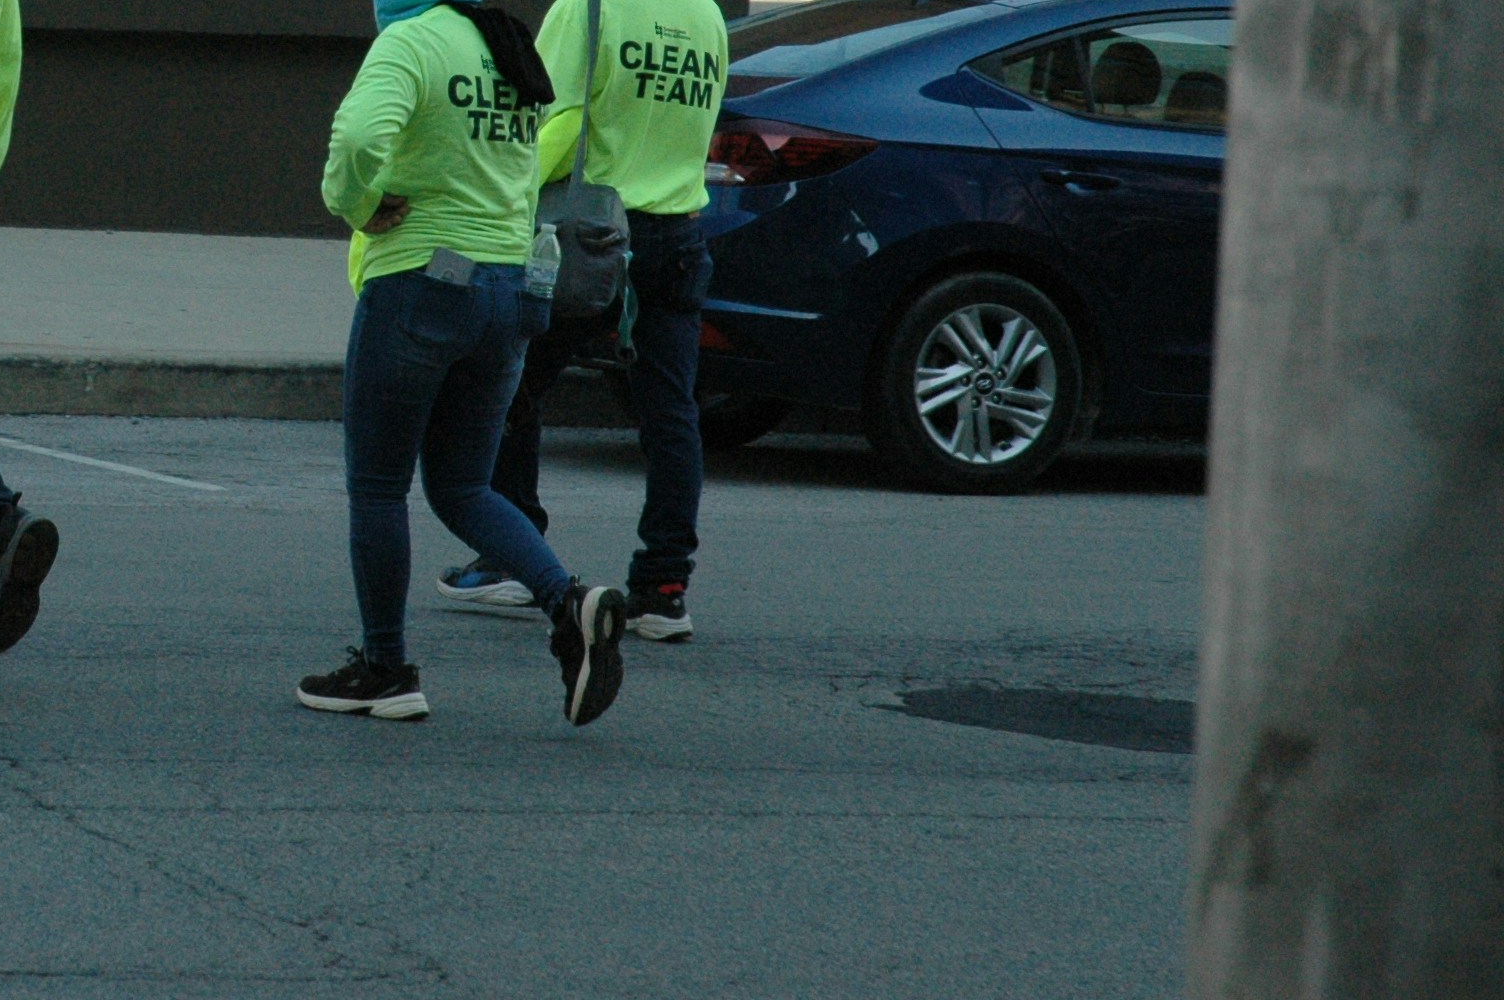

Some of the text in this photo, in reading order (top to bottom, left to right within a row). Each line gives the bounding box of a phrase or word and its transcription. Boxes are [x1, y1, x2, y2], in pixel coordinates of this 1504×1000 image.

[619, 40, 720, 83] CLEAN
[447, 74, 536, 112] CLE
[635, 72, 714, 111] TEAM
